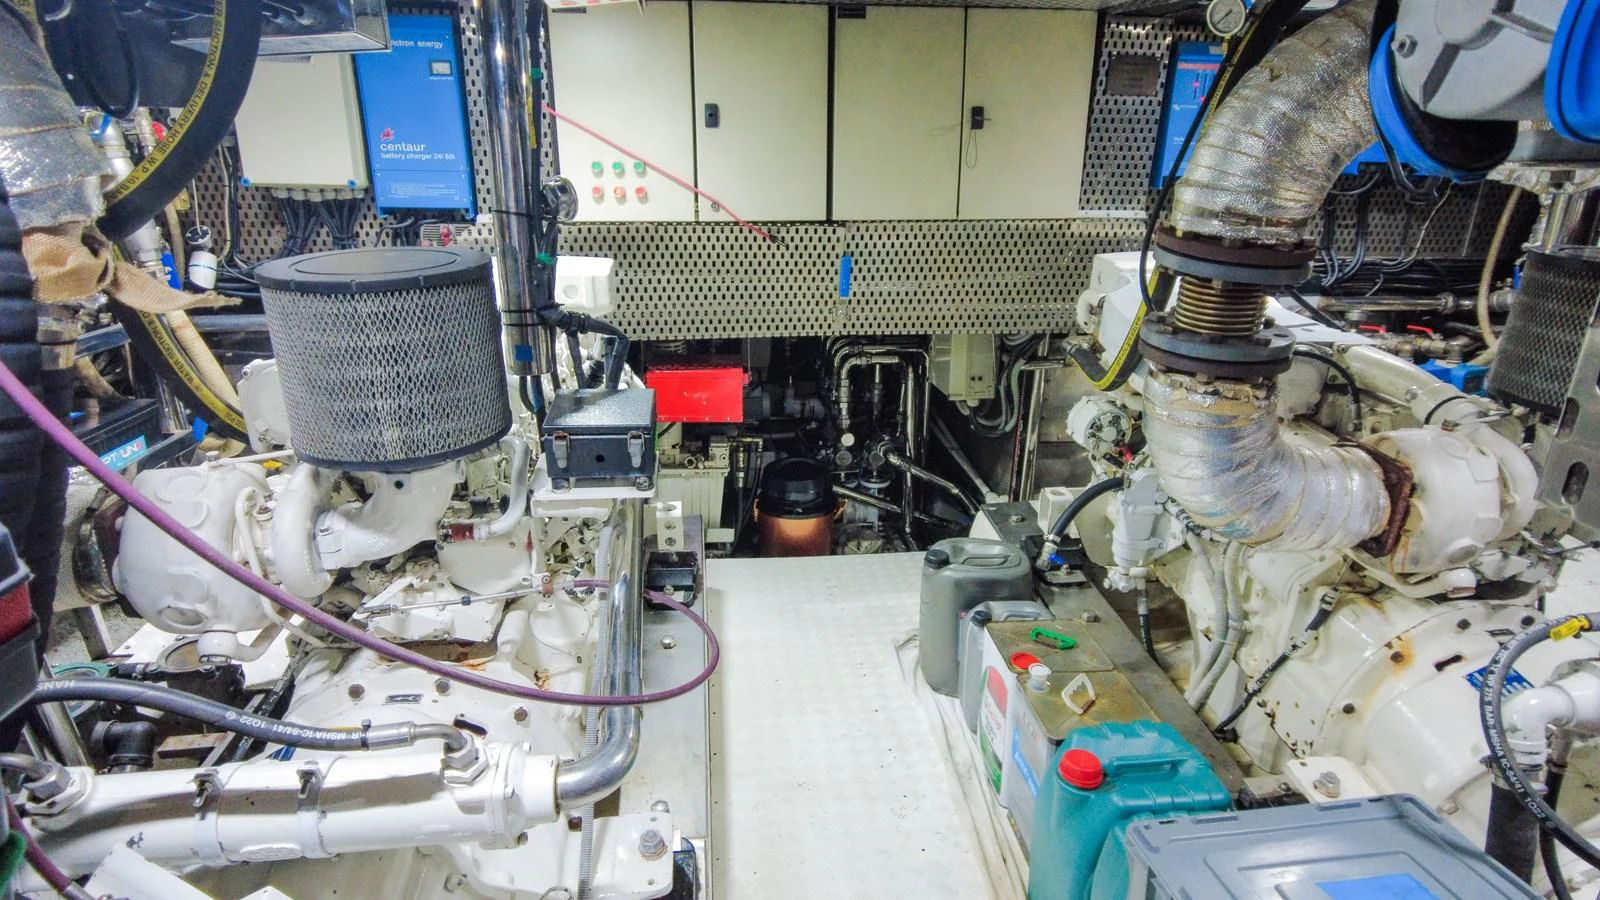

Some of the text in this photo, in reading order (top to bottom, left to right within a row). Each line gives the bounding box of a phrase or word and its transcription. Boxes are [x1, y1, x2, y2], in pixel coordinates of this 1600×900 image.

[207, 20, 223, 70] SUCTION
[417, 40, 444, 49] energy
[179, 80, 208, 128] DELIVERY
[159, 129, 180, 155] HOSE
[380, 141, 426, 152] centaur
[381, 152, 405, 160] battery
[406, 152, 432, 161] charger
[36, 679, 75, 692] HANS
[1485, 705, 1495, 726] BAR
[316, 730, 346, 741] MSHA
